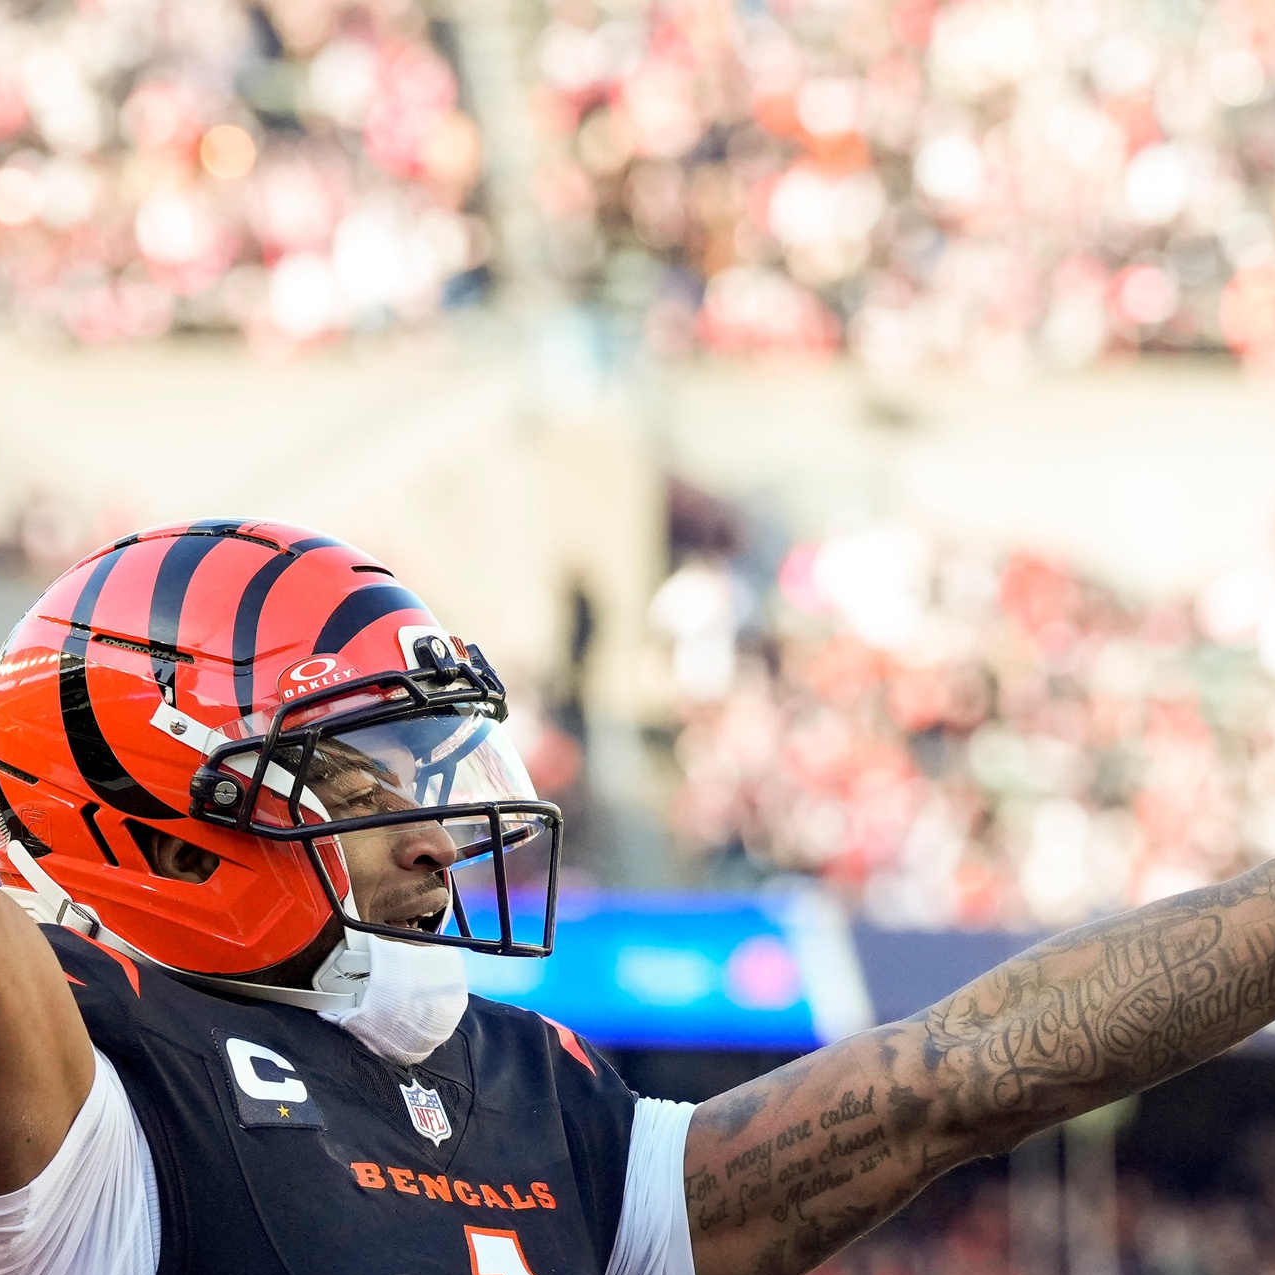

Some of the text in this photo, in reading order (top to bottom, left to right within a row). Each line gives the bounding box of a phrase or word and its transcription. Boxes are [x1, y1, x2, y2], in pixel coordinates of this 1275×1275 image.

[284, 669, 352, 699] OAKLEY
[1108, 987, 1169, 1050] OVER
[226, 1037, 308, 1103] C
[414, 1106, 446, 1131] NFL
[725, 1139, 774, 1179] many
[776, 1119, 813, 1151] are
[819, 1085, 875, 1130] called
[778, 1157, 814, 1185] are
[818, 1124, 886, 1165] chosen
[350, 1161, 558, 1211] BENGALS
